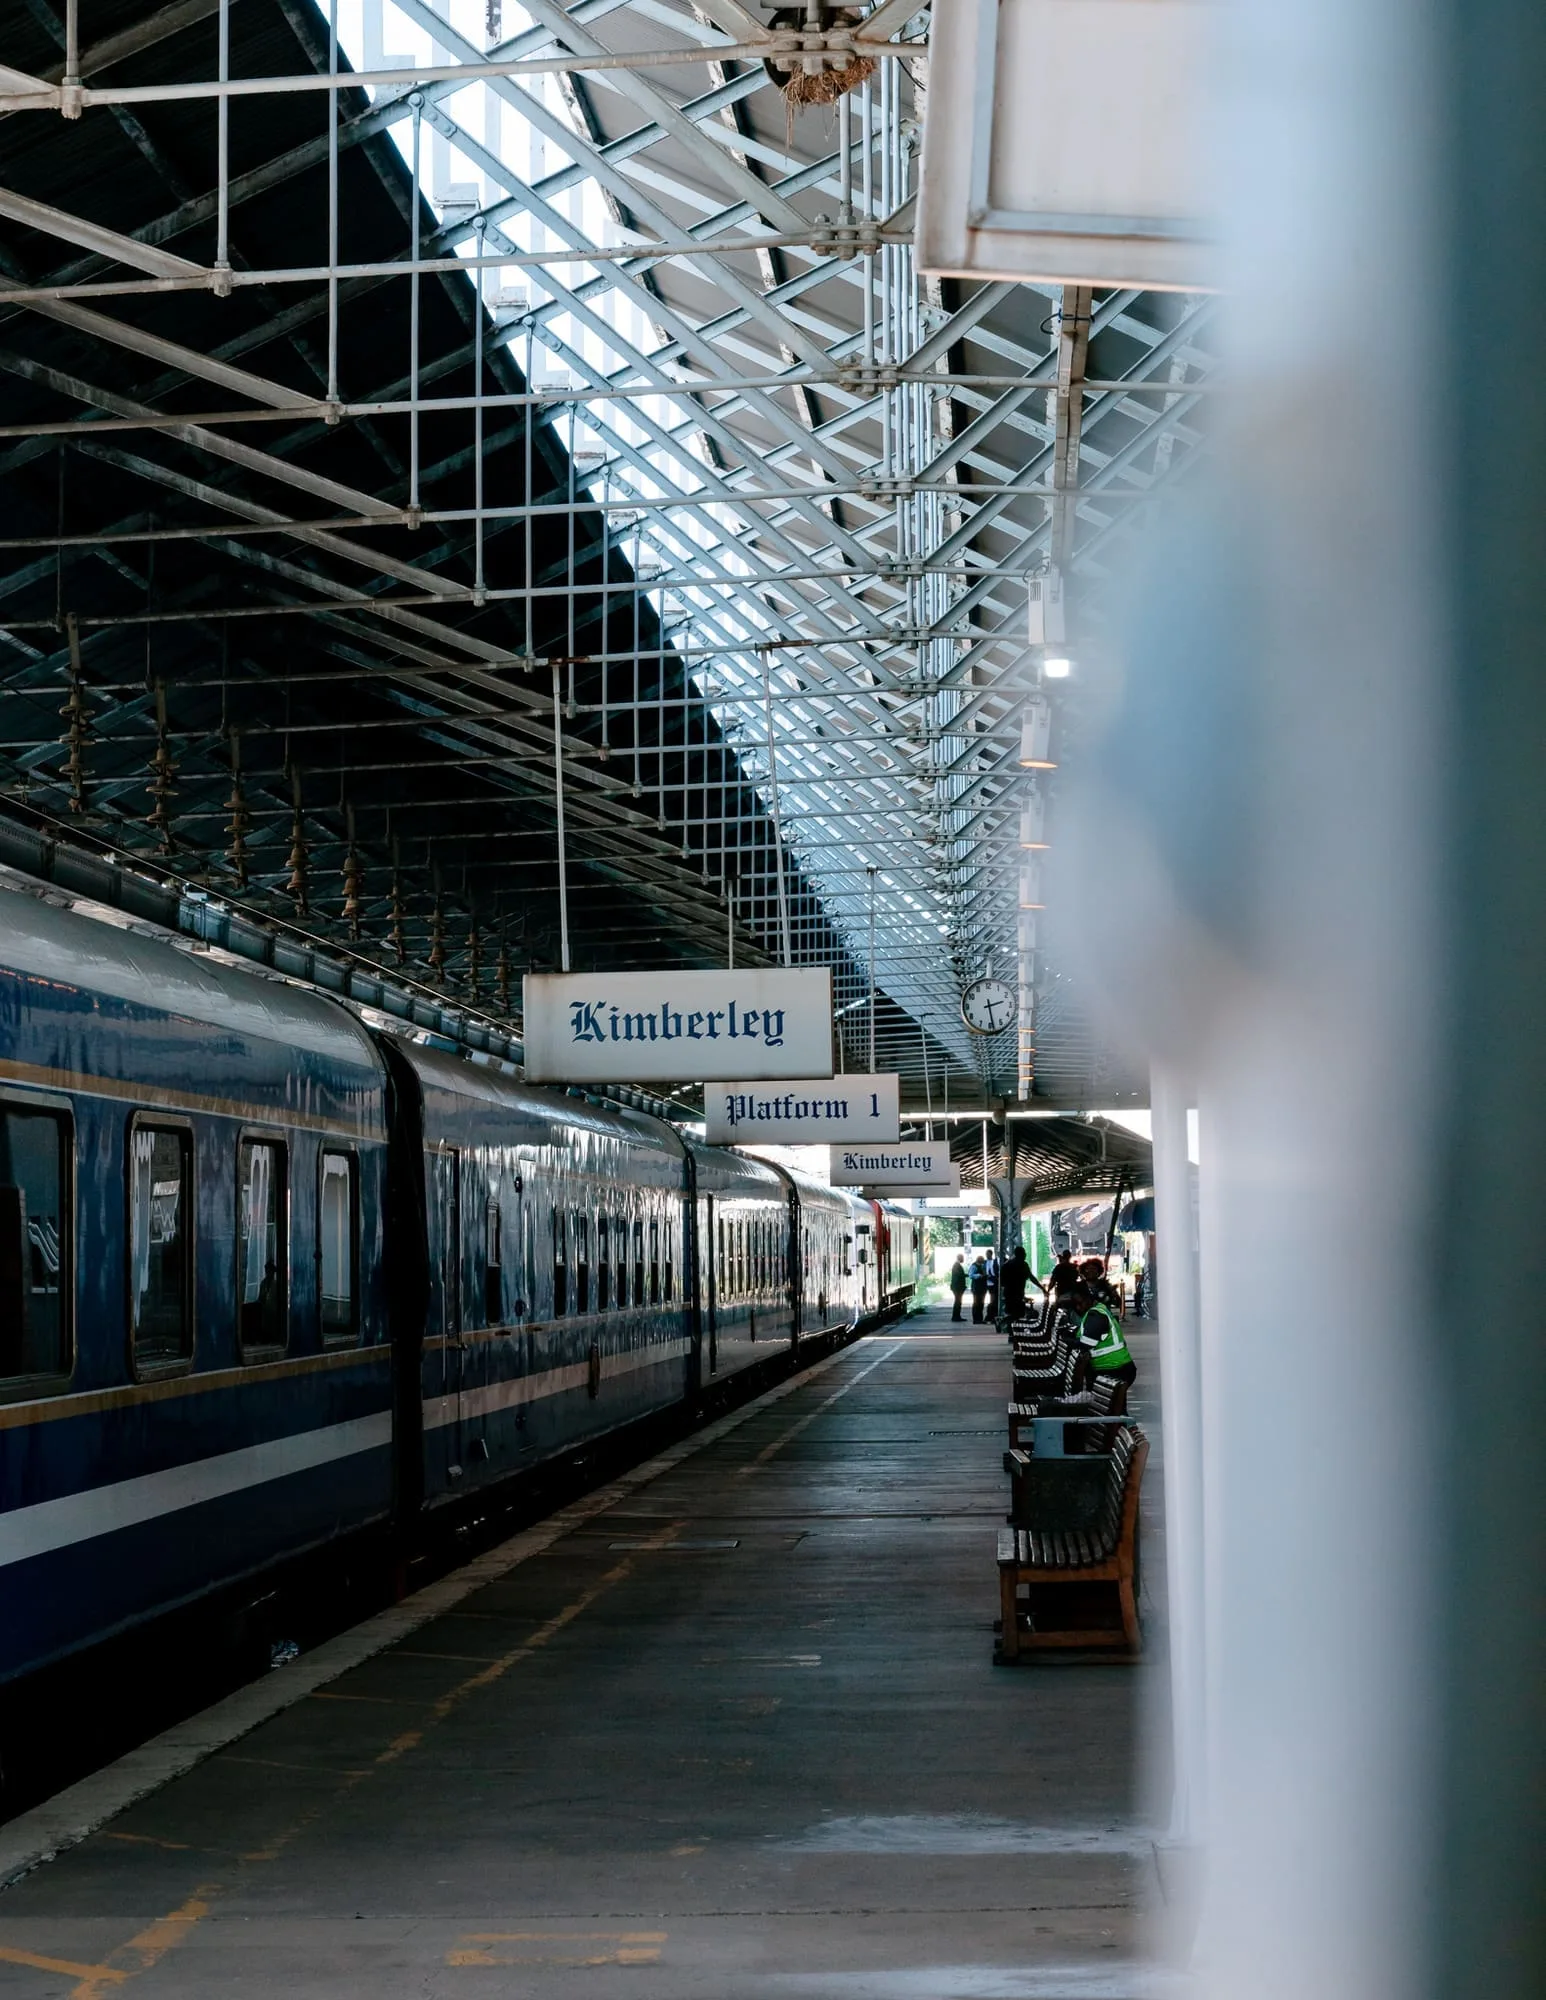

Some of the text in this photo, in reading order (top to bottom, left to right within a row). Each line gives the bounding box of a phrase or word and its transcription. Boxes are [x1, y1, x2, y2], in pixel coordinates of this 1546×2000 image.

[985, 982, 992, 990] 12
[569, 1000, 786, 1047] Kimberley
[725, 1093, 881, 1127] Platform 1
[843, 1152, 932, 1173] Kimberley
